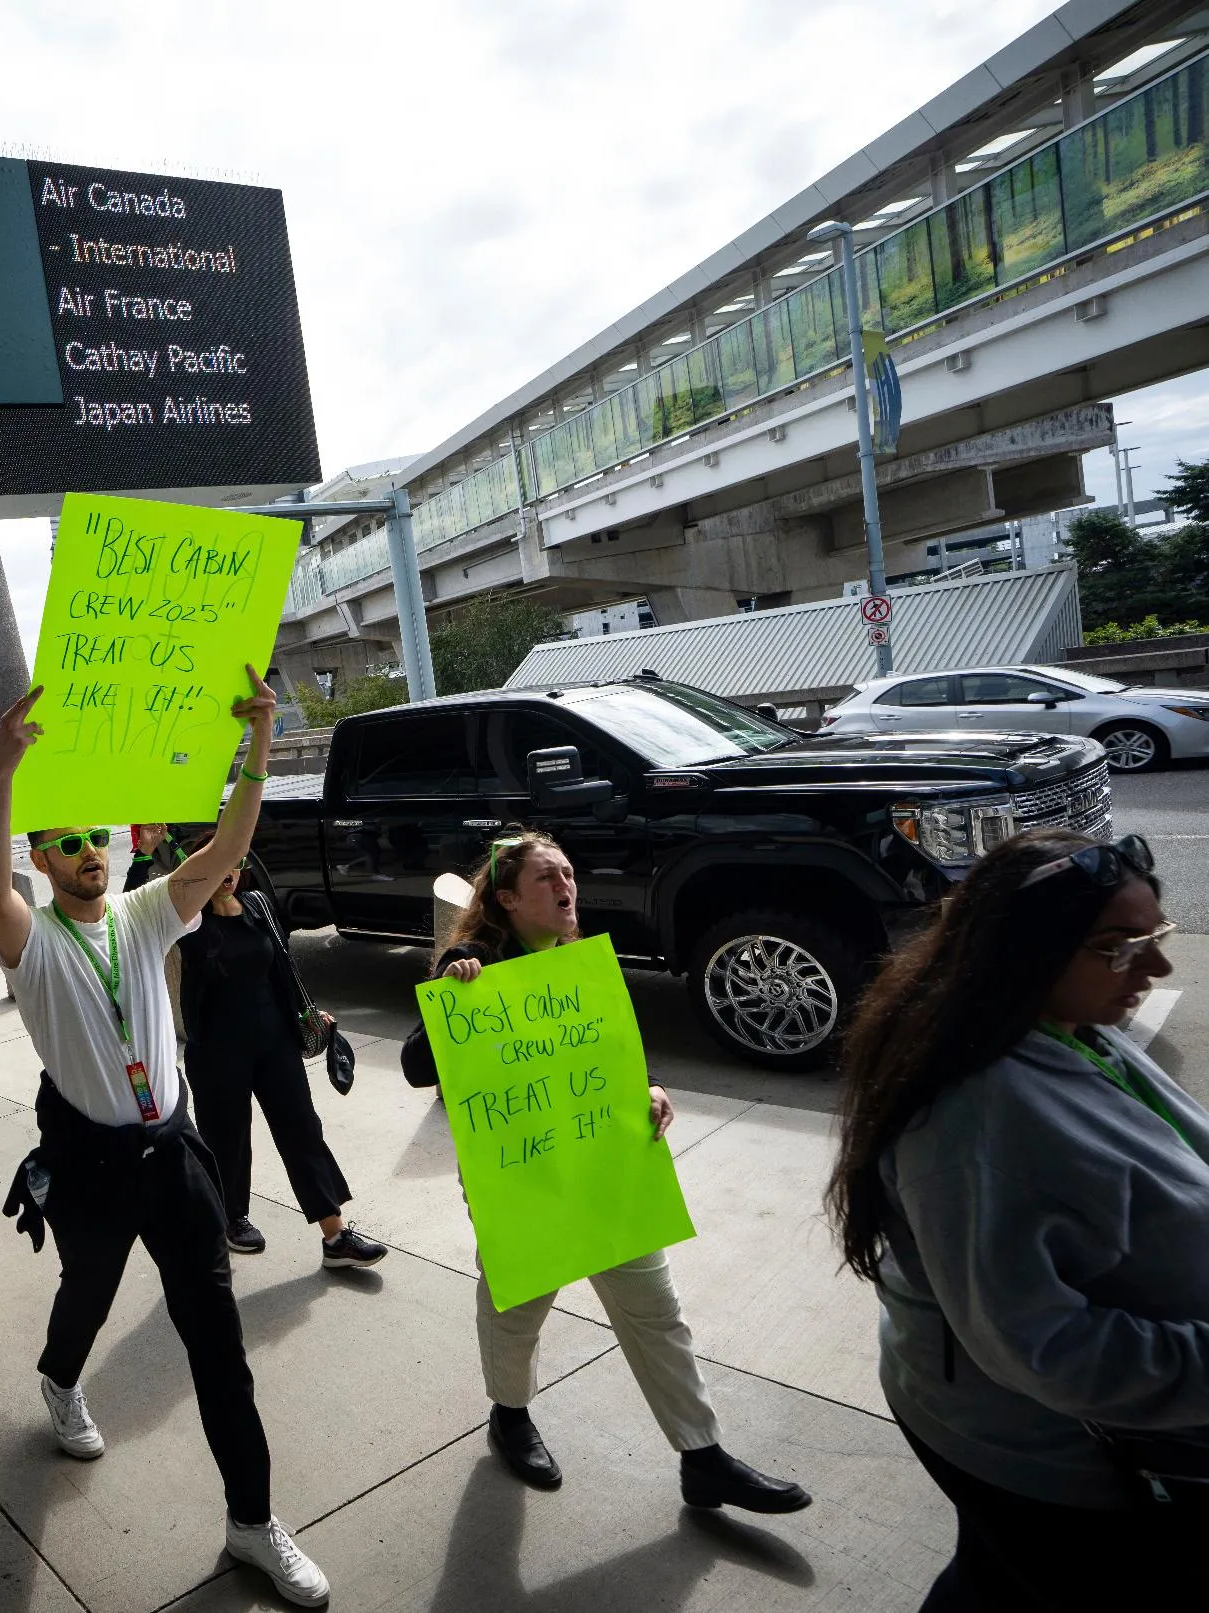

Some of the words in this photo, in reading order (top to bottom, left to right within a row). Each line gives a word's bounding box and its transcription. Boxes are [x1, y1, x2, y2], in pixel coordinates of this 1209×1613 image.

[41, 176, 79, 208] Air
[87, 183, 188, 220] Canada
[71, 233, 237, 275] International
[57, 287, 95, 318] Air
[105, 291, 193, 323] France
[65, 342, 159, 379] Cathay
[168, 346, 248, 376] Pacific
[74, 397, 155, 430] Japan
[162, 398, 252, 427] Airlines
[70, 590, 144, 621] CREW
[55, 633, 136, 671] TREAT
[150, 642, 195, 673] US
[62, 681, 122, 709] LIKE
[458, 1075, 552, 1133] TREAT
[568, 1066, 607, 1098] US
[500, 1128, 558, 1169] LIKE
